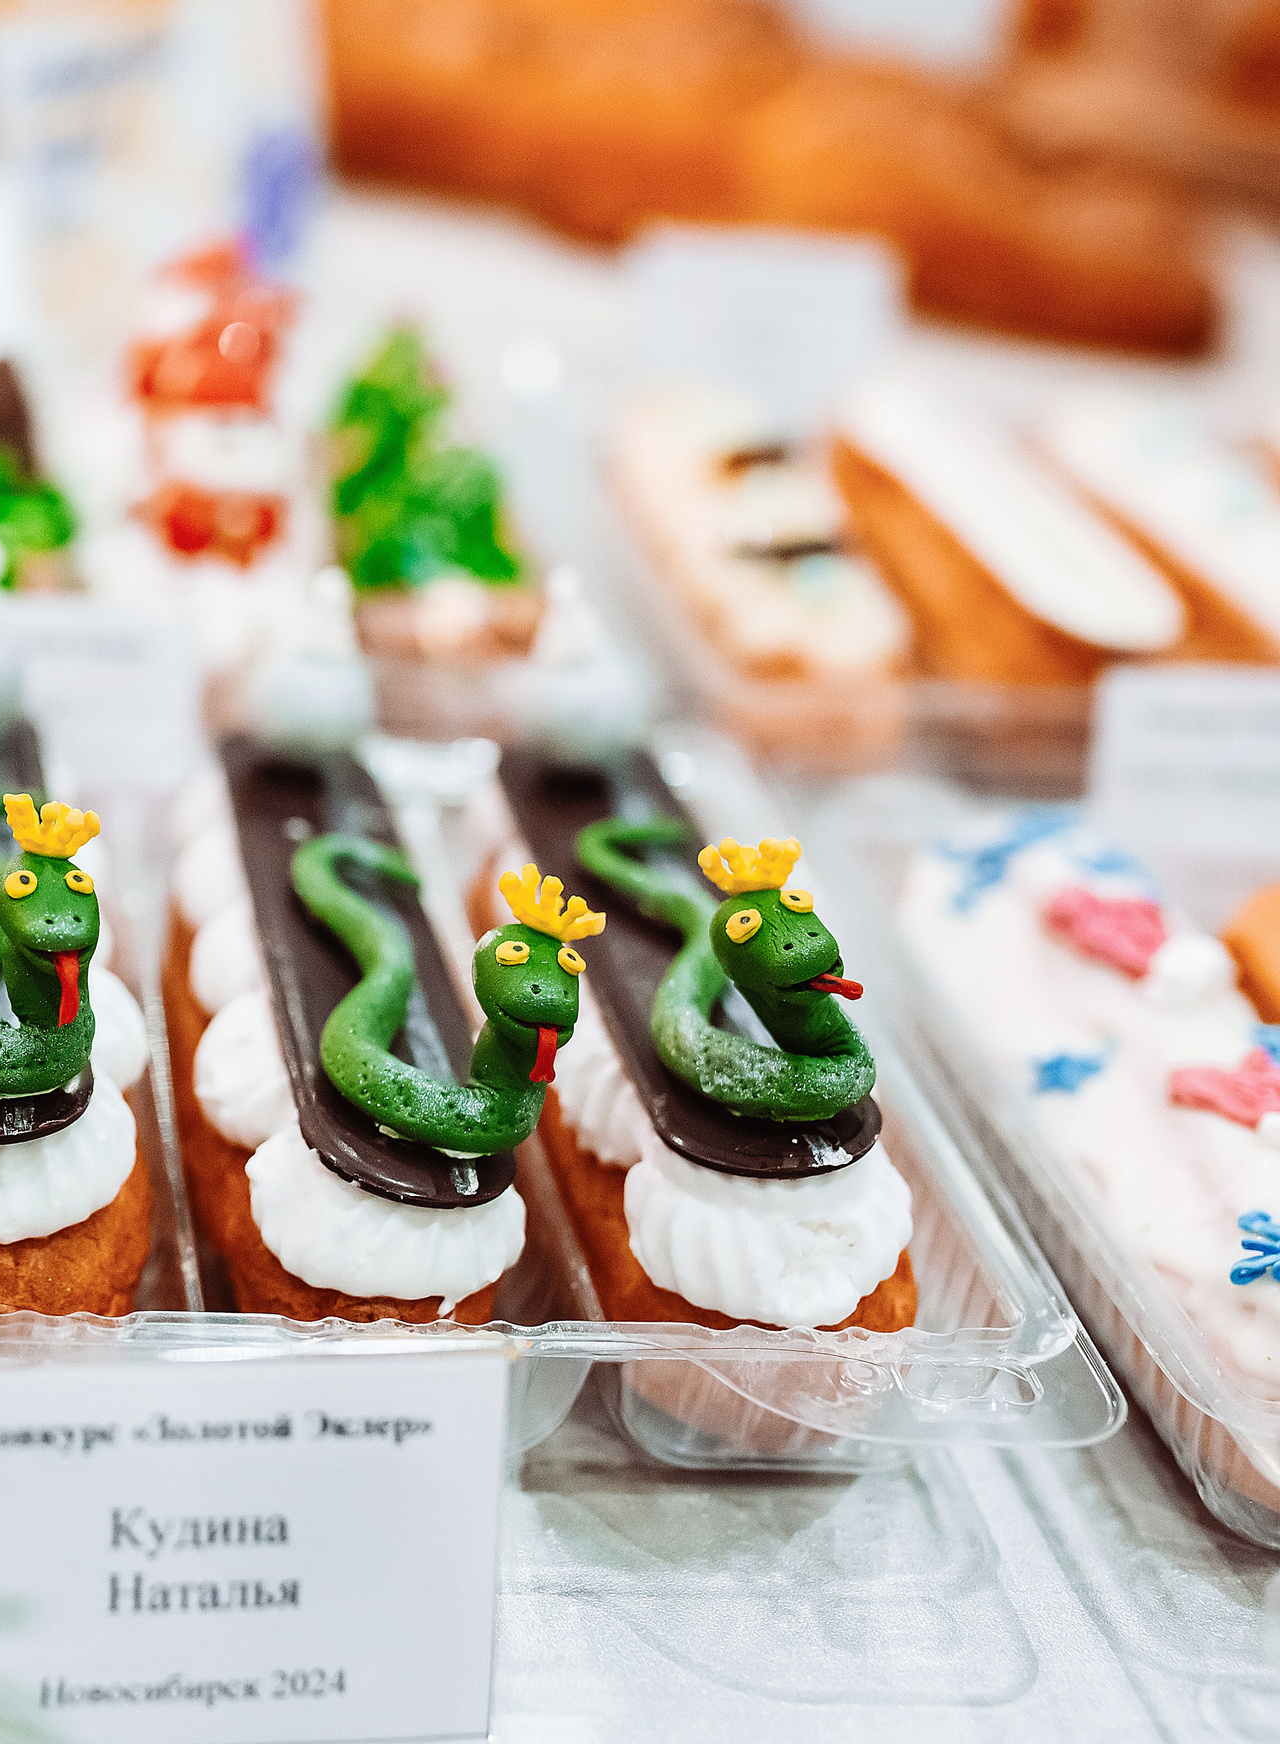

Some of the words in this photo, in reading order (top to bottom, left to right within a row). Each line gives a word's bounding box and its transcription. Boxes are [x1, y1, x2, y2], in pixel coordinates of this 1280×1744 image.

[132, 1410, 291, 1444] «Золотой
[110, 1505, 289, 1559] Кудина
[108, 1572, 301, 1615] Наталья
[39, 1672, 259, 1711] Новосибирск
[271, 1667, 347, 1699] 2024
